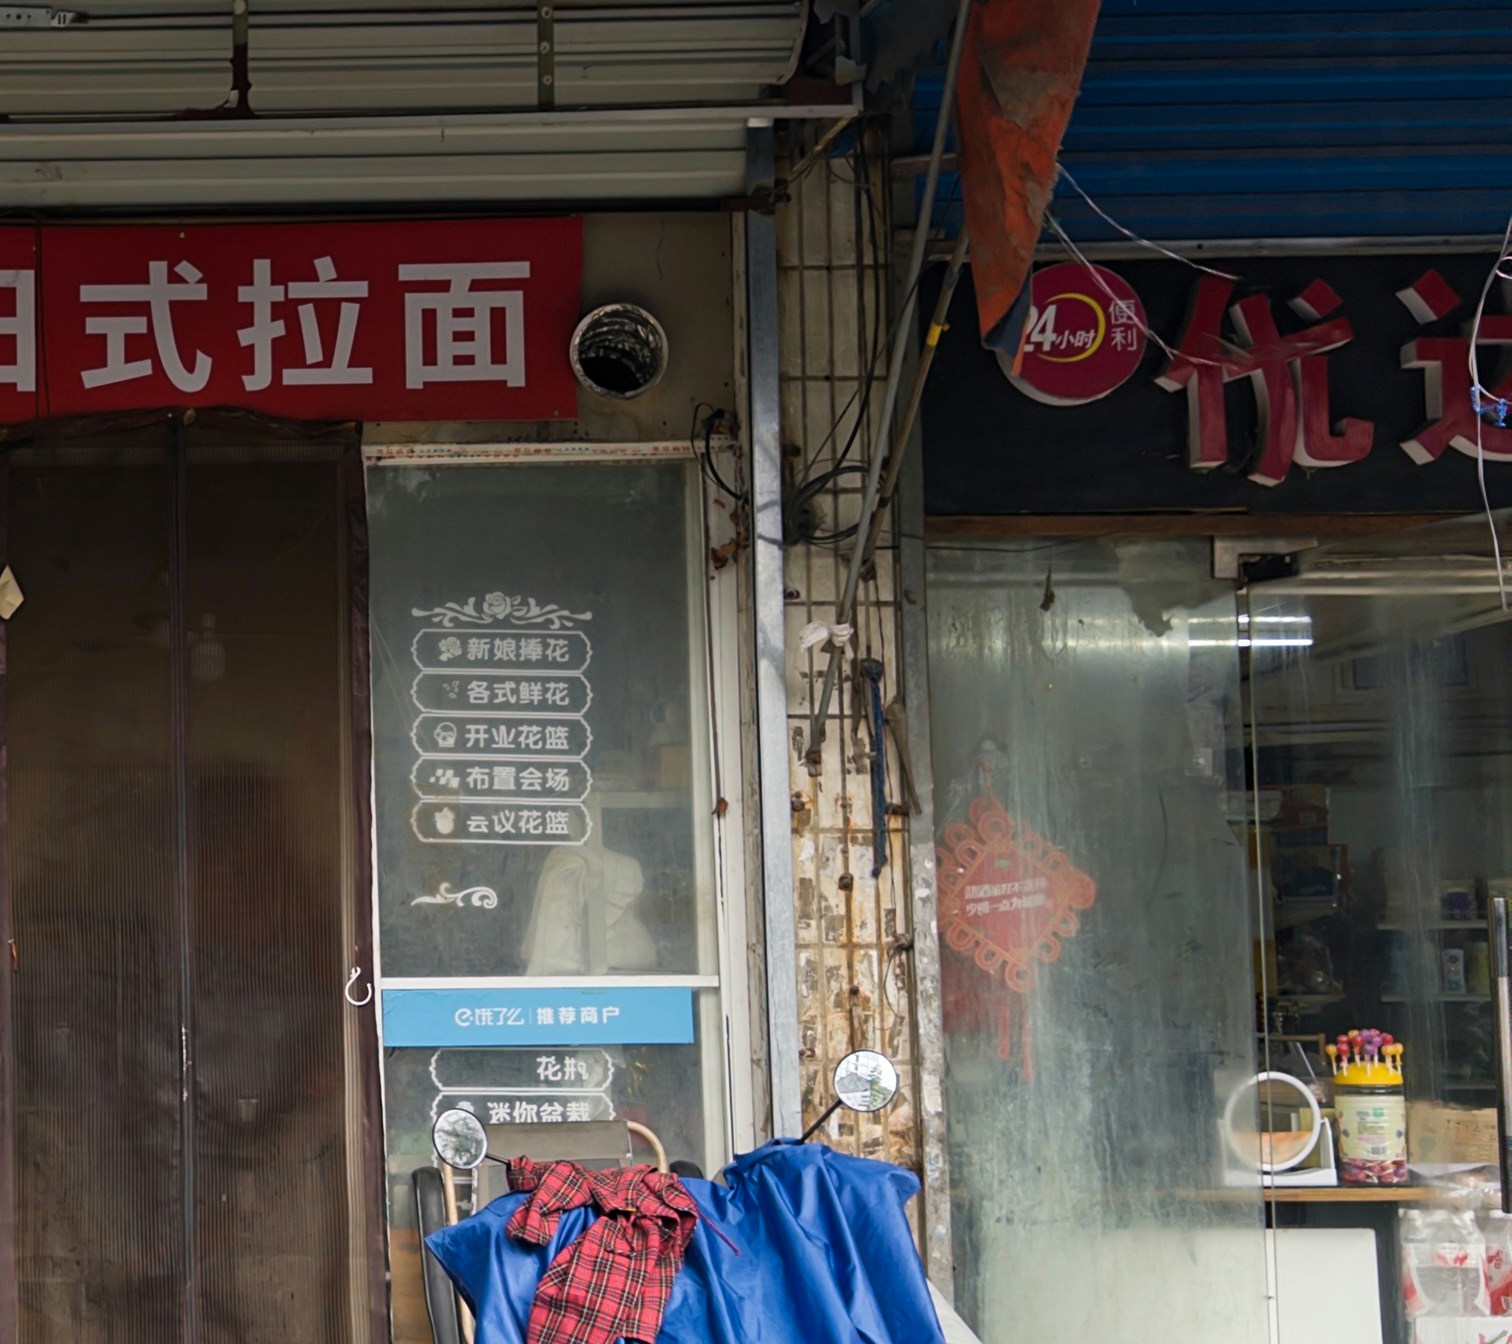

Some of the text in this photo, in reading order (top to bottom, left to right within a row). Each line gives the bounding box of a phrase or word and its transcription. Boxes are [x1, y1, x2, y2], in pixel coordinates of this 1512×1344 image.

[467, 637, 569, 662] 新娘捧花
[467, 680, 570, 705] 各式鲜花
[465, 724, 569, 750] 开业花篮
[466, 766, 569, 791] 布置会场
[536, 1006, 620, 1025] 推荐商户
[487, 1101, 591, 1124] 迷你盆栽
